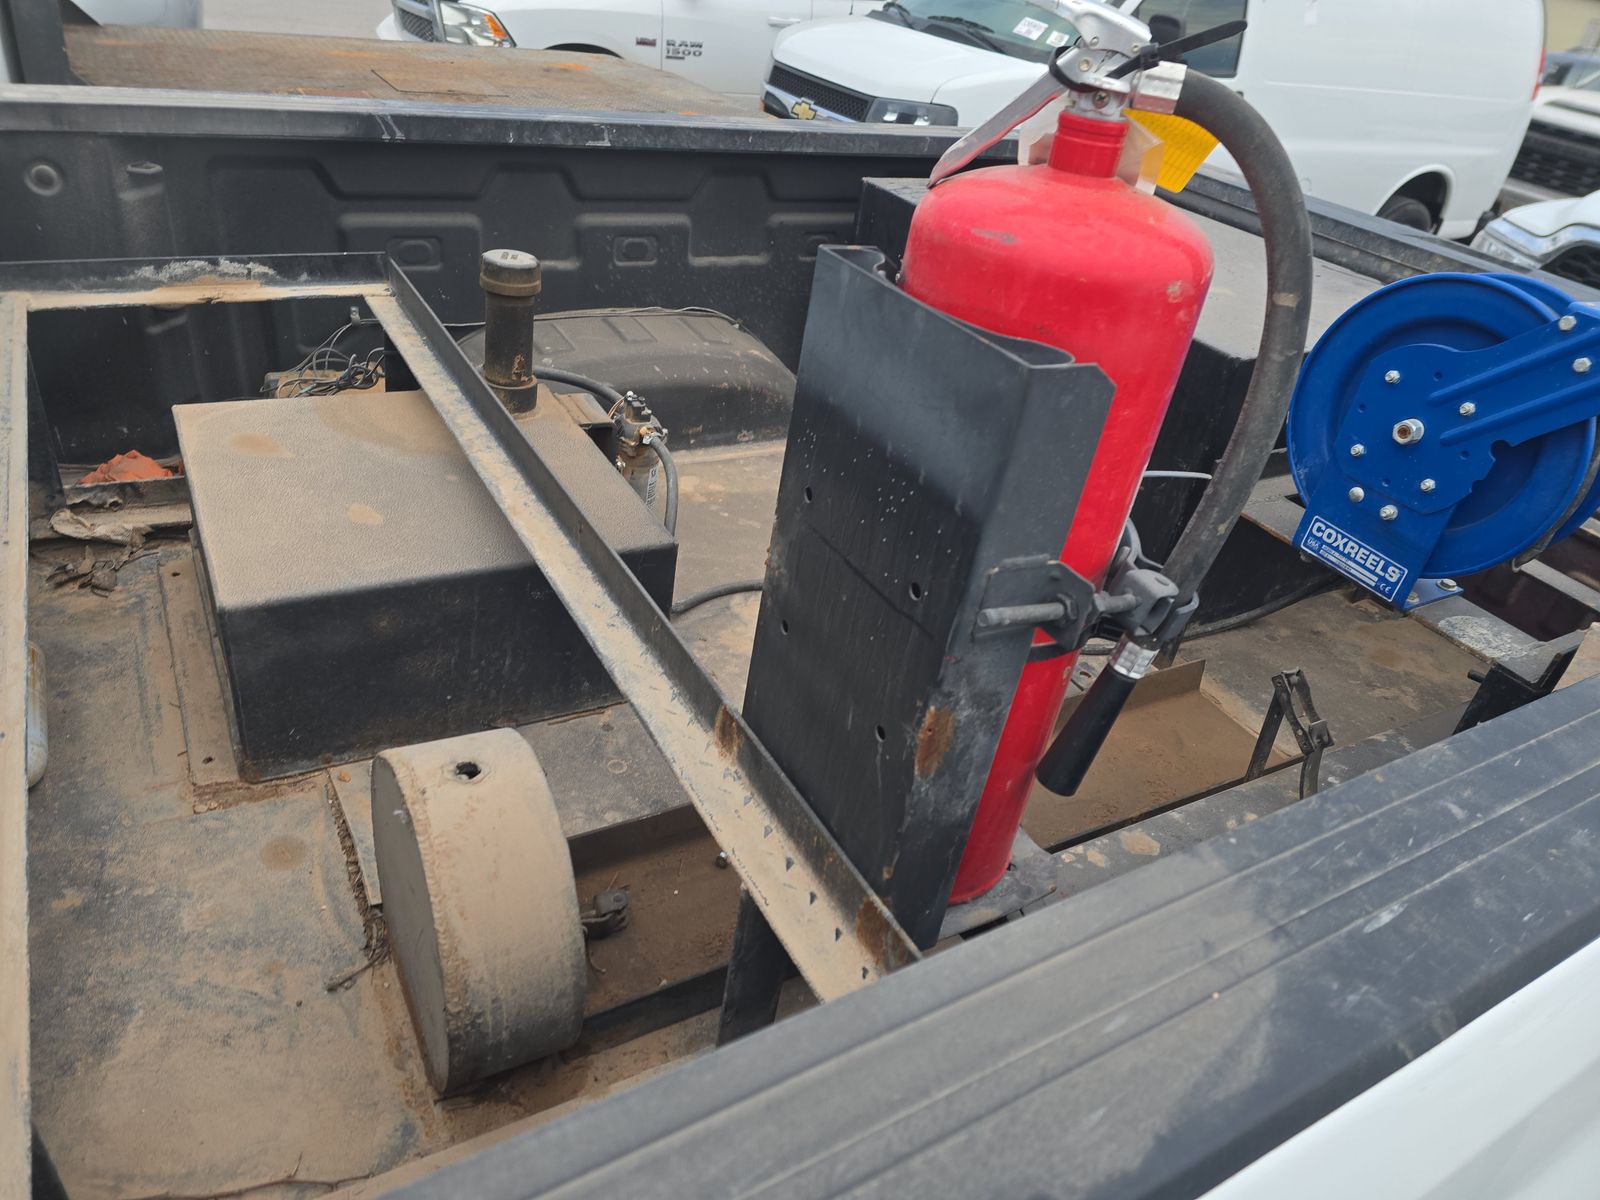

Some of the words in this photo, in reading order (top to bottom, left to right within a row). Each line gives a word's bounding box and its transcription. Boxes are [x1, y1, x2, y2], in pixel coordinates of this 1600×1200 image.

[666, 39, 703, 48] RAM
[666, 48, 702, 57] 1500
[1312, 522, 1401, 583] COXREELS
